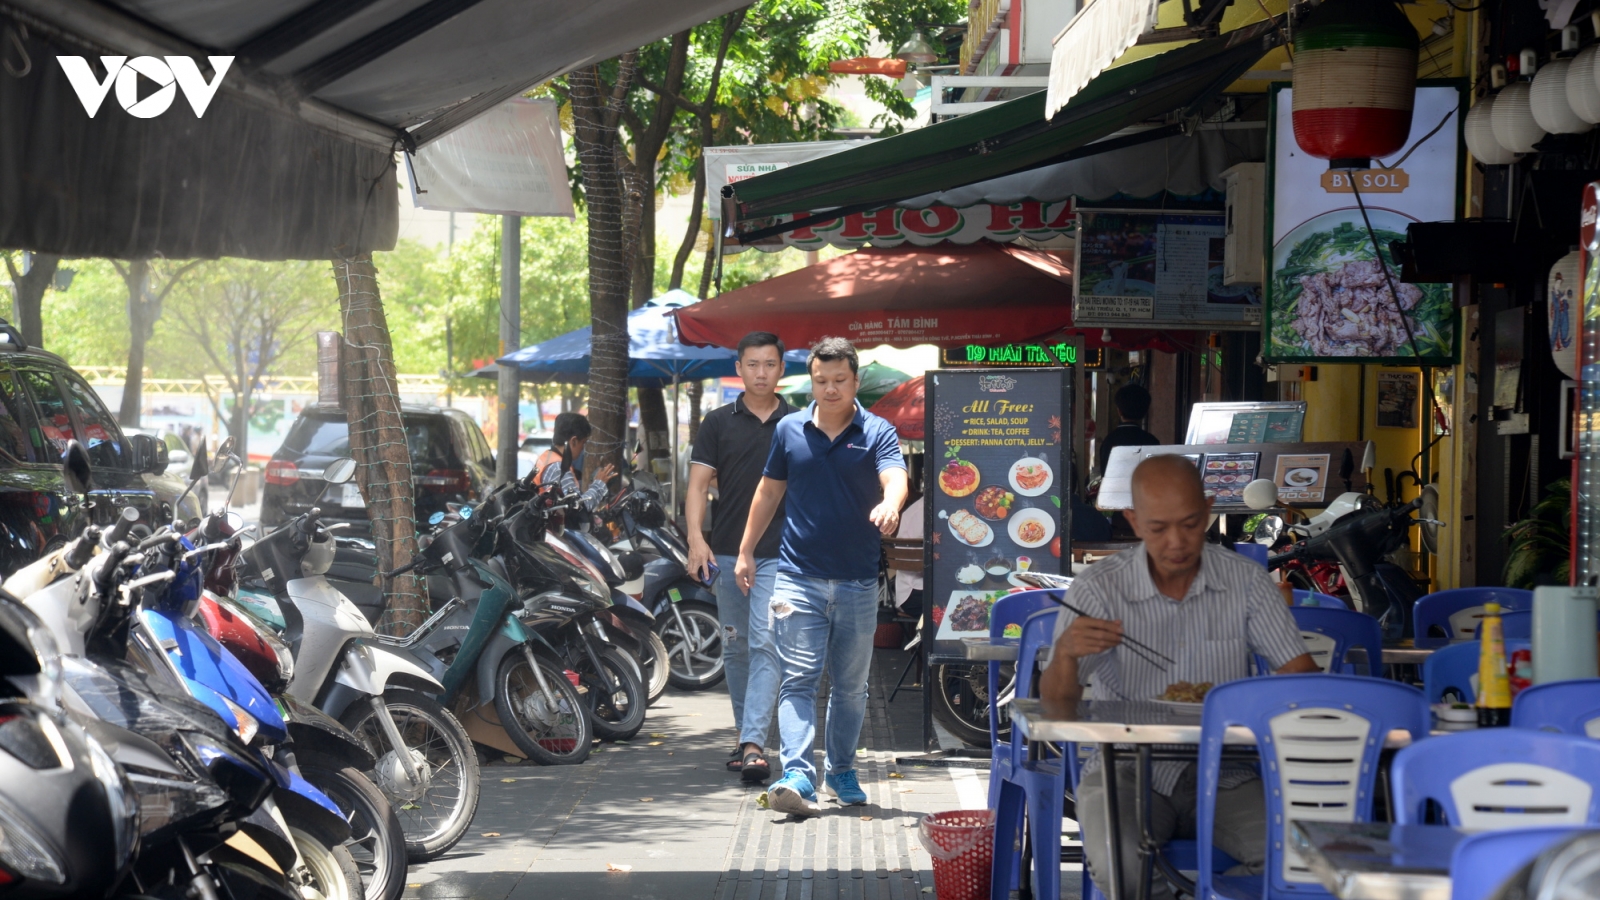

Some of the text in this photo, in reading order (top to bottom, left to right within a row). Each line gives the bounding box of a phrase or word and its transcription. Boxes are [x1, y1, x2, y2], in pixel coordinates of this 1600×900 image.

[1332, 174, 1400, 188] BY SOL
[864, 320, 883, 330] HÀNG
[888, 316, 911, 329] TÁM
[913, 317, 938, 329] BÌNH
[966, 344, 987, 362] 19
[962, 400, 1034, 416] All Free:
[969, 417, 1029, 426] RICE, SALAD, SOUP
[968, 427, 1030, 436] DRINK: TEA, COFFEE
[981, 438, 1003, 446] PANNA
[1004, 438, 1027, 447] COTTA,
[1027, 438, 1046, 446] JELLY
[550, 604, 576, 613] HONDA
